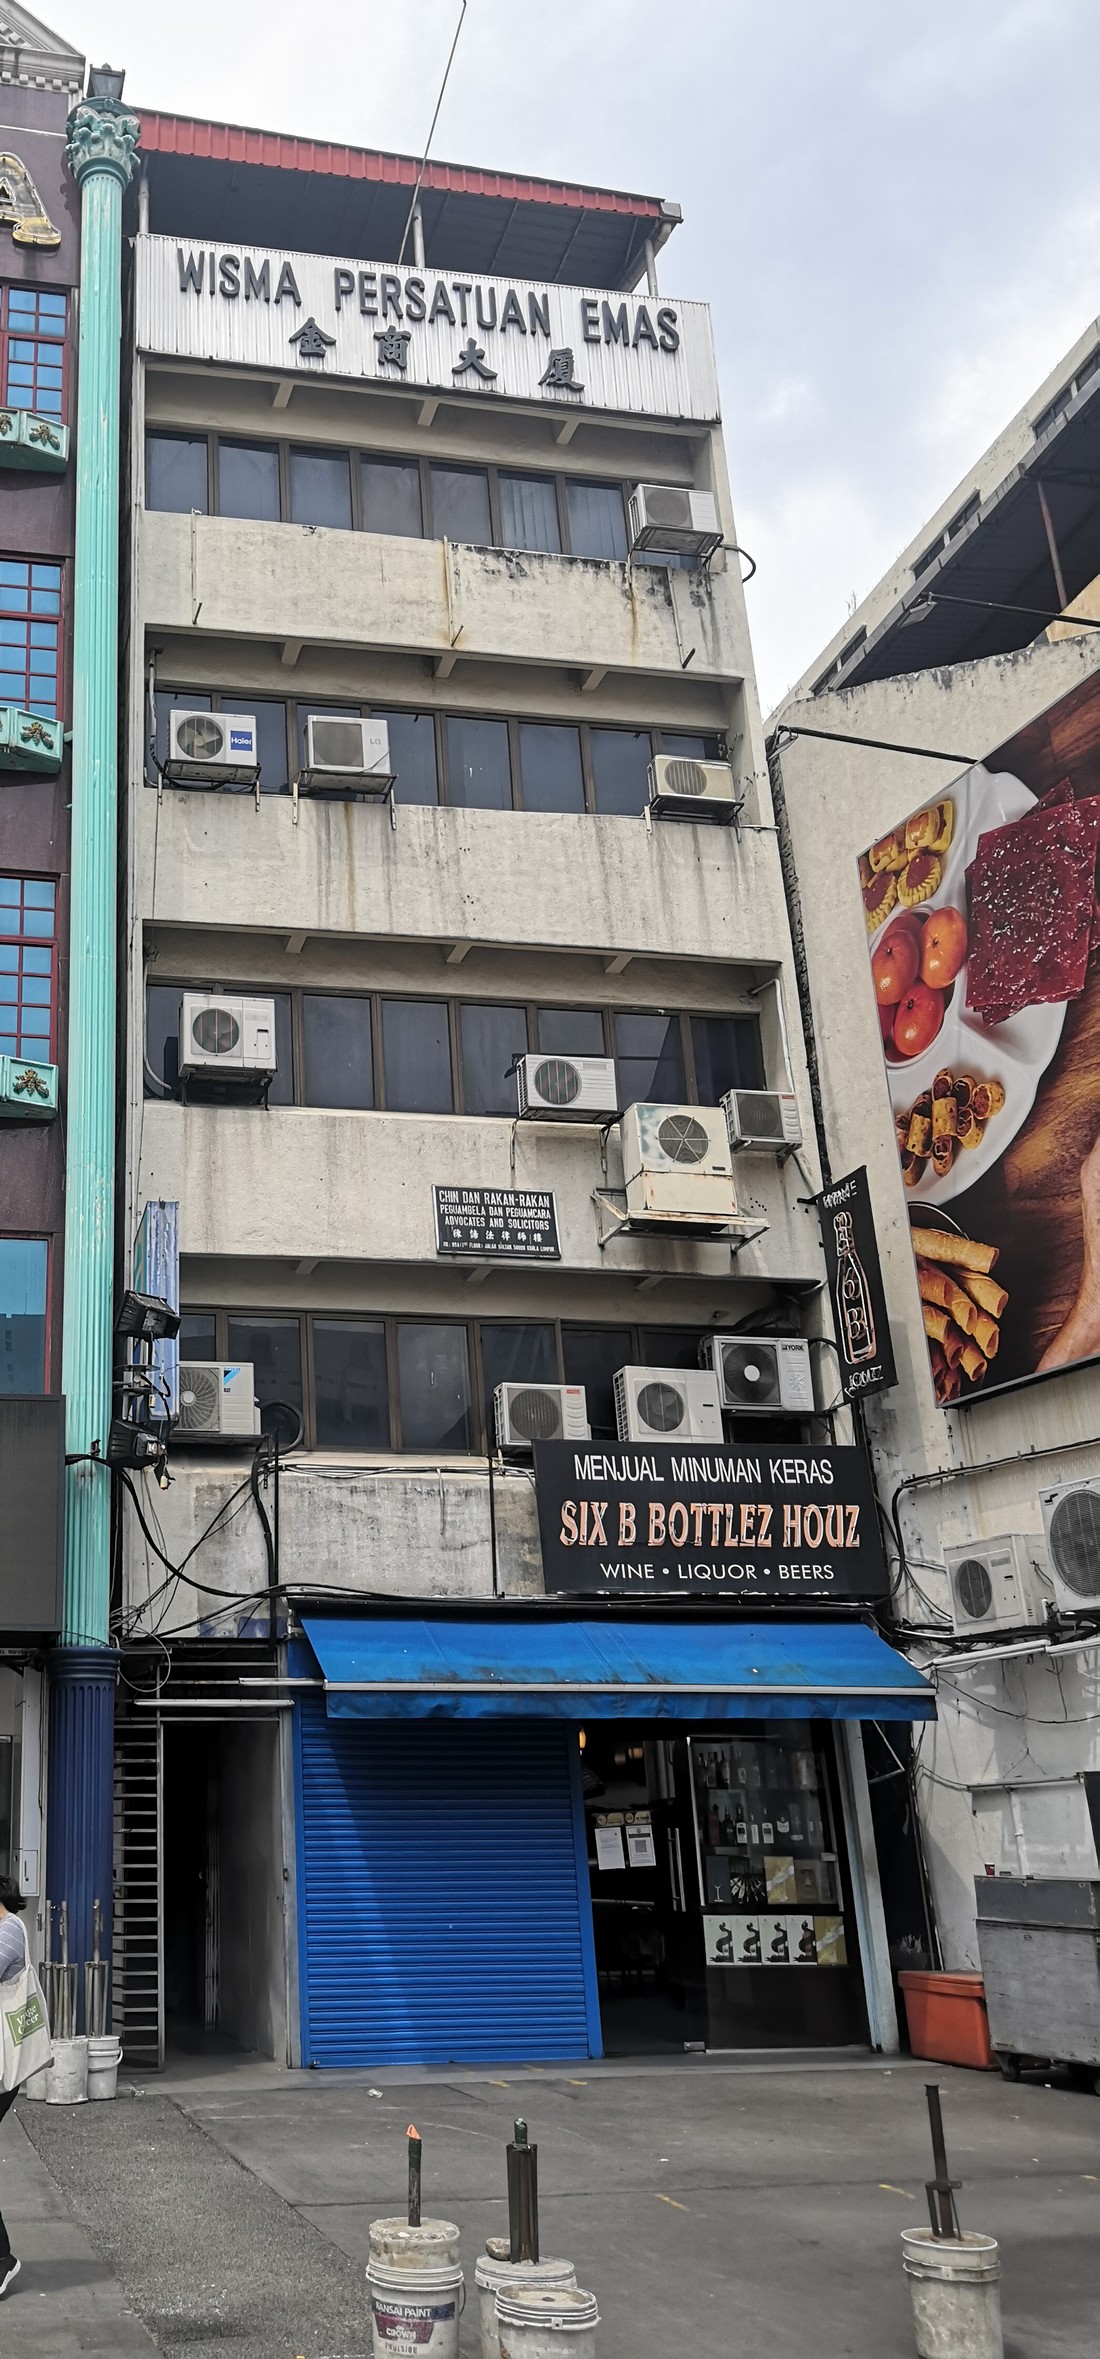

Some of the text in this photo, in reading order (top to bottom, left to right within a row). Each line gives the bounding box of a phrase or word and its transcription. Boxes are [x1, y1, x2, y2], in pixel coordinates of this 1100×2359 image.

[176, 247, 682, 353] WISMA PERSATUAN EMAS
[231, 736, 252, 746] Haier
[438, 1190, 551, 1208] CHIN DAN RAKAN-RAKAN
[440, 1204, 552, 1220] PEGUAMBELA DAN PEGUAMCARA
[445, 1216, 550, 1231] ADVOCATES AND SOLICITORS
[574, 1454, 834, 1485] MENJUAL MINUMAN KERAS
[559, 1500, 861, 1549] SIX B BOTTLEZ HOUZ
[600, 1563, 835, 1581] WINE LIQUOR BEERS
[404, 2307, 432, 2318] PAINT
[386, 2327, 417, 2340] CROWN
